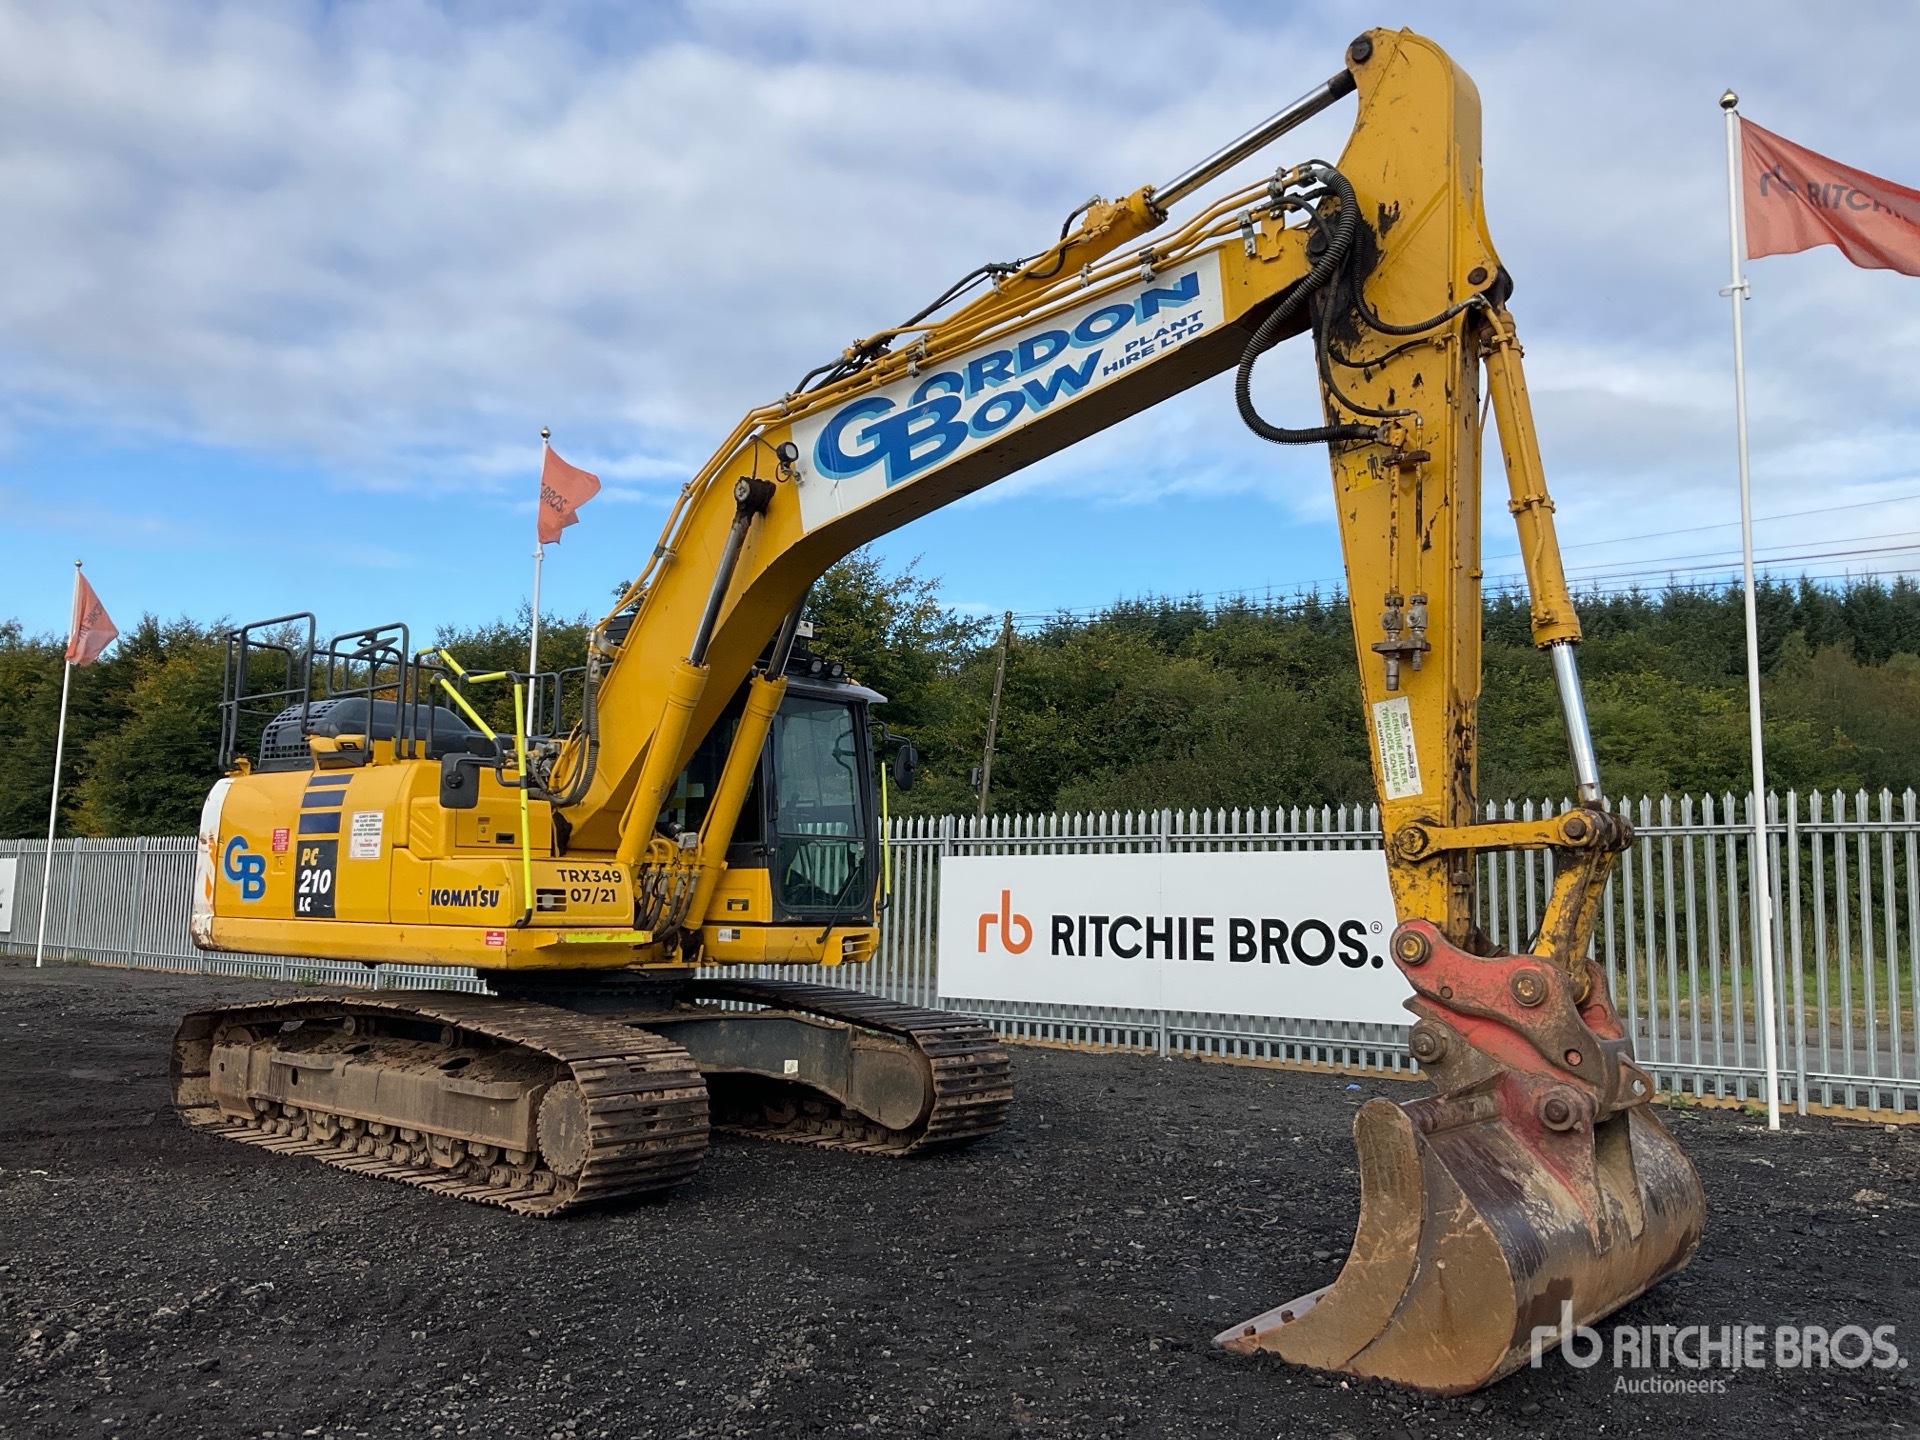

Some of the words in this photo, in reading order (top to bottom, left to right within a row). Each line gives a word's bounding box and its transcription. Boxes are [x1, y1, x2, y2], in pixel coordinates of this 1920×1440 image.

[1807, 182, 1910, 220] RITC
[1103, 344, 1155, 376] HIRE
[1161, 323, 1204, 348] LTD
[1125, 310, 1202, 353] PLANT
[813, 271, 1200, 480] GORDON
[883, 348, 1104, 489] BOW
[1382, 707, 1395, 751] TWINLOCK
[1389, 754, 1401, 793] COUPLER
[1391, 712, 1403, 751] GENUINE
[1397, 752, 1409, 784] MILLER
[223, 835, 266, 901] GB
[301, 848, 319, 866] PC
[557, 869, 622, 884] TRX349
[299, 869, 331, 894] 210
[431, 885, 499, 907] KOMATSU
[570, 887, 616, 904] 07/21
[299, 897, 311, 912] LC
[978, 890, 1033, 955] rb
[1051, 914, 1214, 962] RITCHIE
